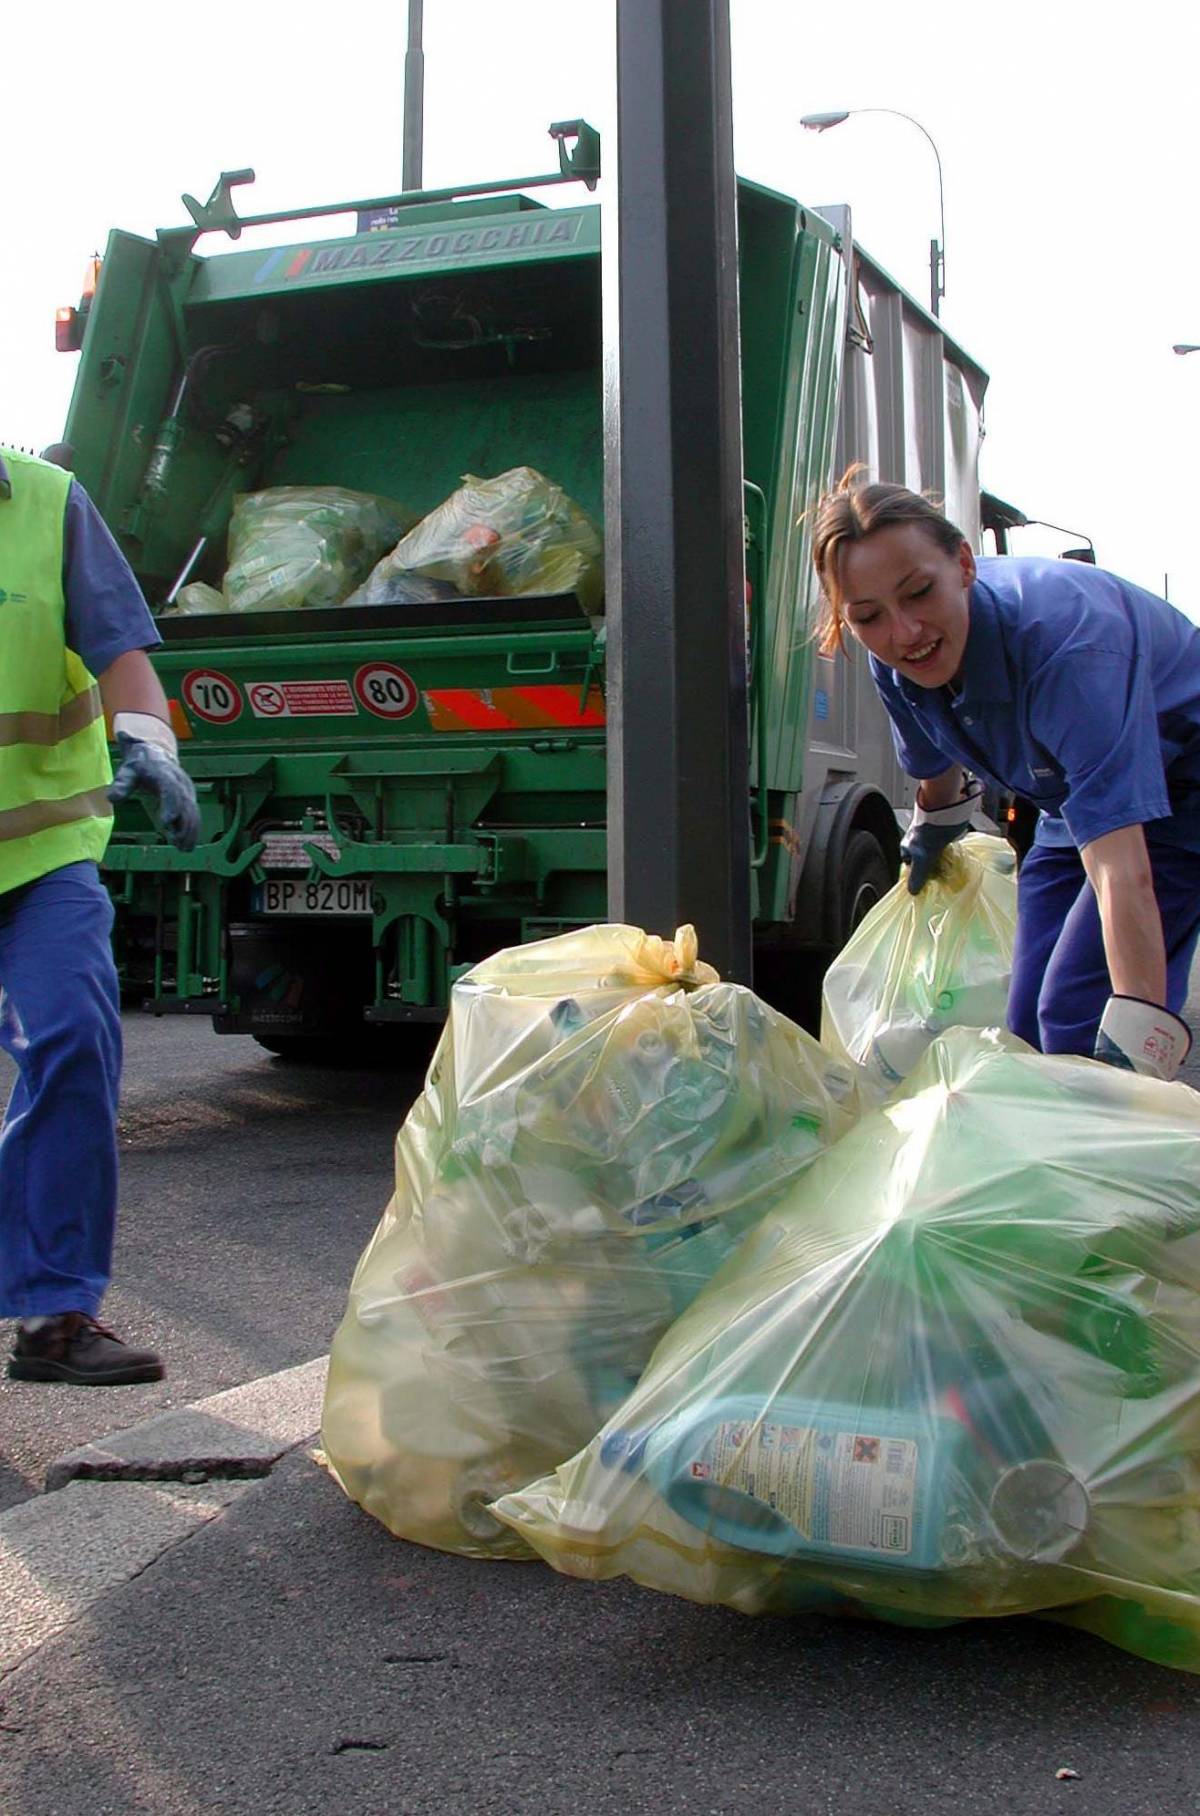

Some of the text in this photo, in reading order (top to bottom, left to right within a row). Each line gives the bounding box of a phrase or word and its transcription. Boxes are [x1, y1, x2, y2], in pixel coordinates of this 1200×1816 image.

[311, 218, 571, 272] MAZZOCCHIA
[195, 684, 230, 710] 70
[368, 677, 405, 704] 80
[267, 882, 295, 910] BP
[306, 882, 374, 911] 820M
